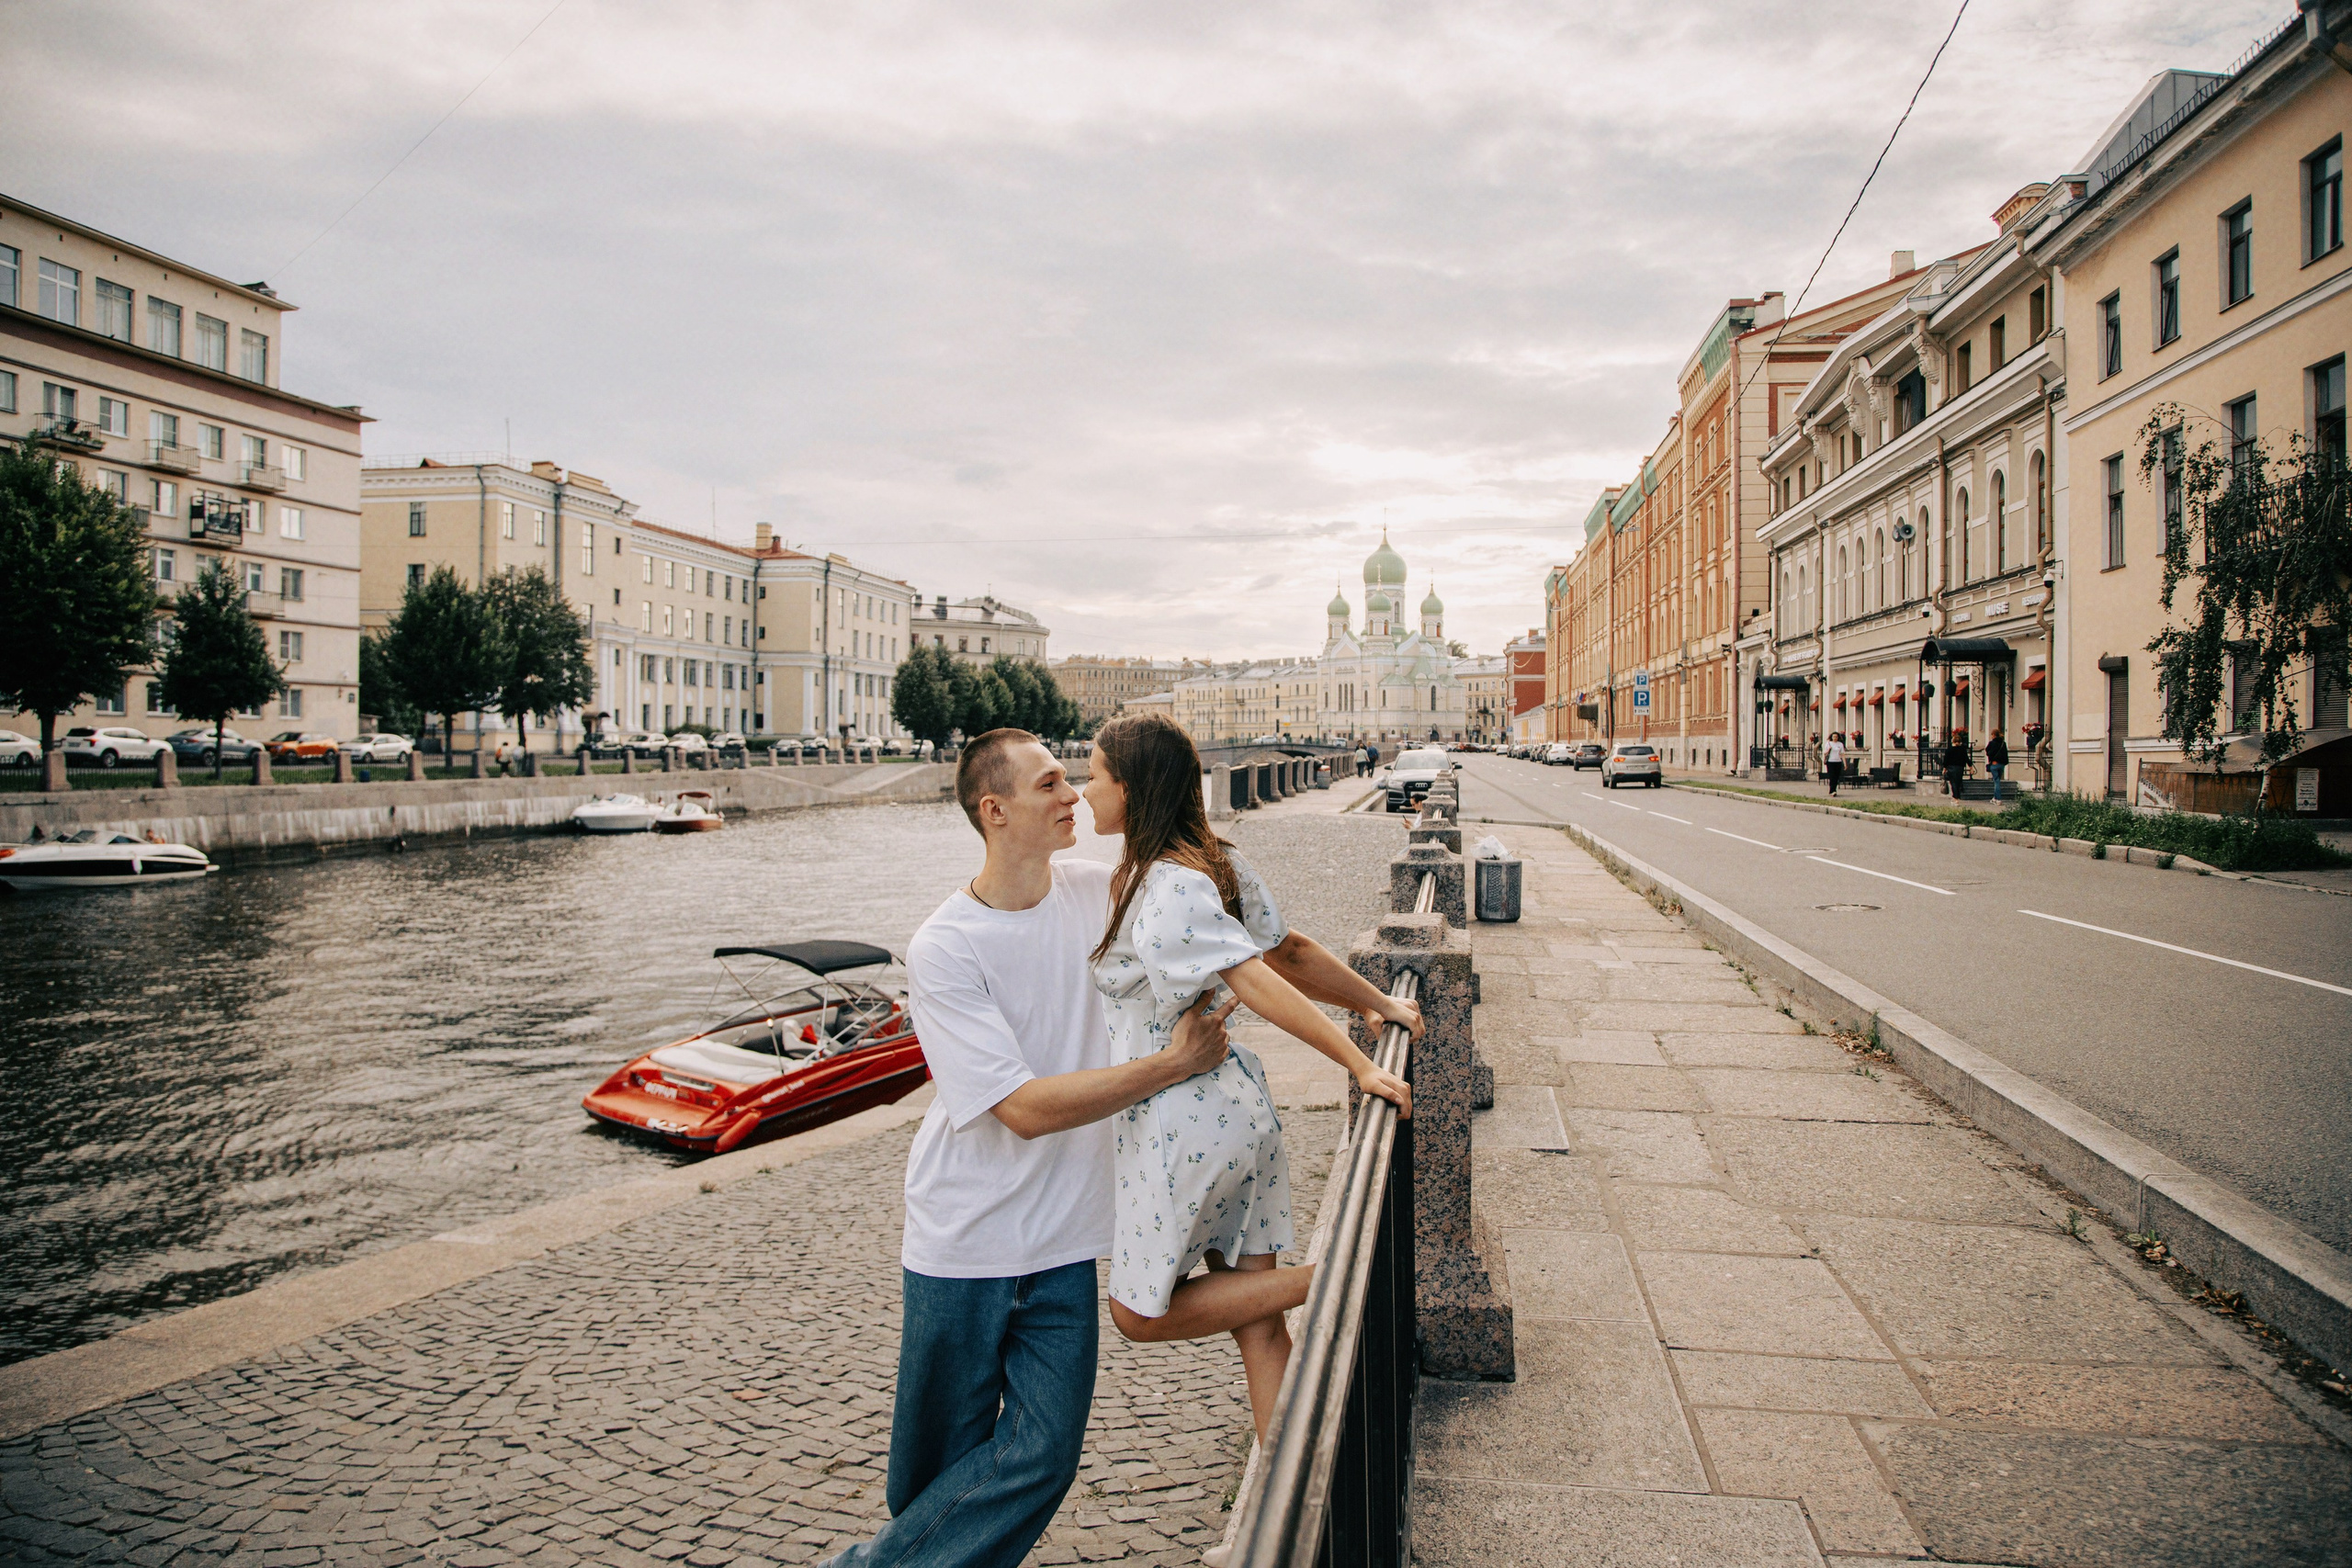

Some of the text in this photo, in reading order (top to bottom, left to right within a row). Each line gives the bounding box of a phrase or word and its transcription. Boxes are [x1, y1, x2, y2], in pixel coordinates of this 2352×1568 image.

[1984, 601, 2009, 617] MUSE
[1638, 675, 1645, 685] P
[1637, 692, 1647, 705] P
